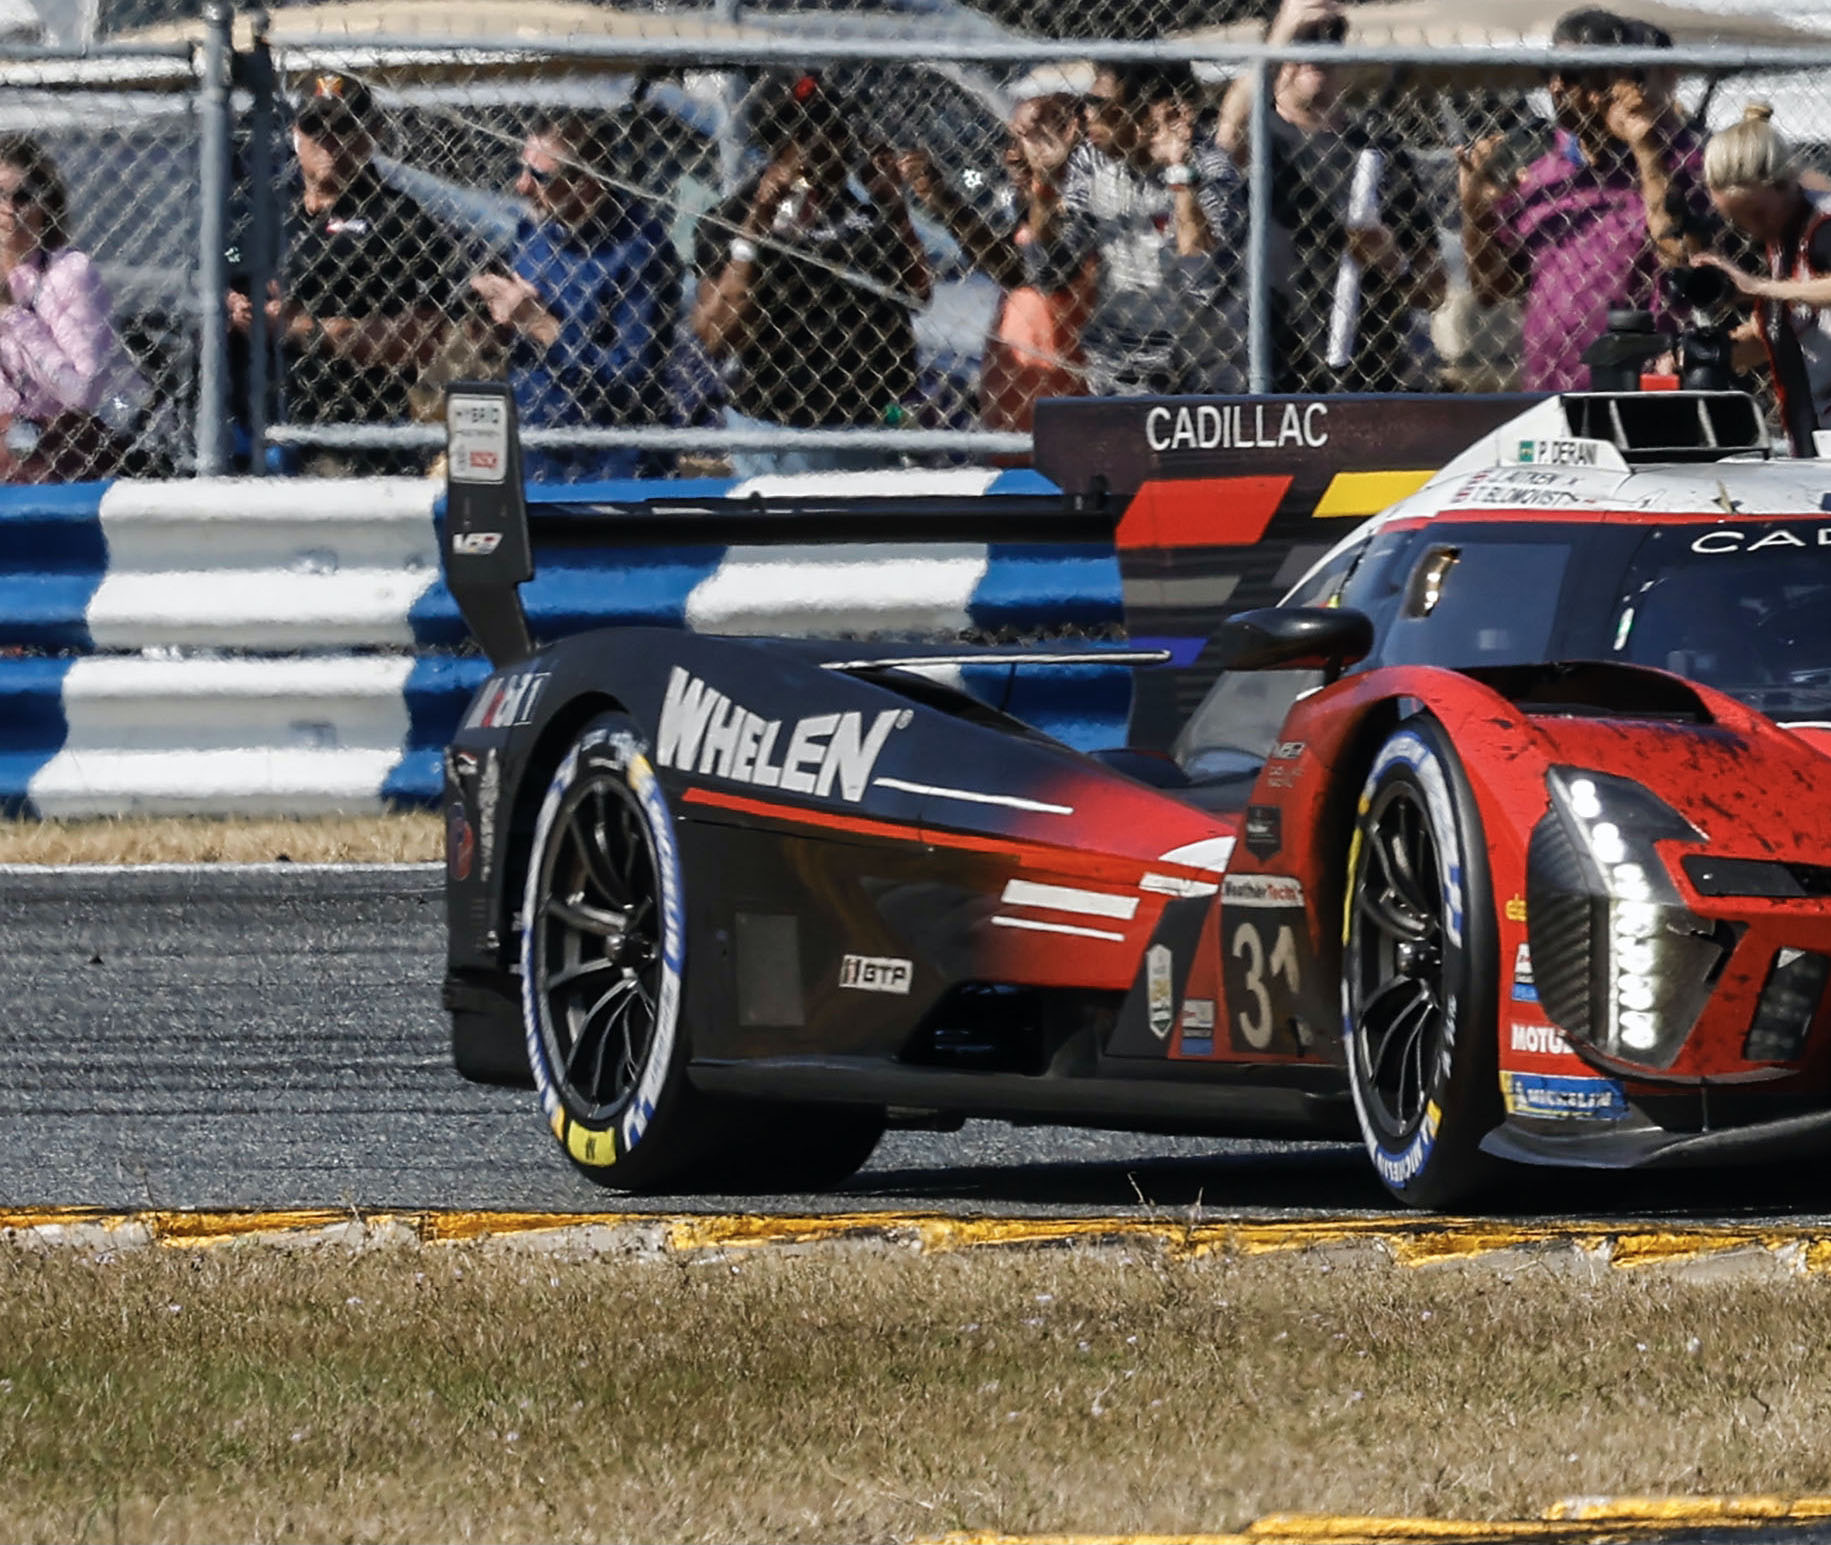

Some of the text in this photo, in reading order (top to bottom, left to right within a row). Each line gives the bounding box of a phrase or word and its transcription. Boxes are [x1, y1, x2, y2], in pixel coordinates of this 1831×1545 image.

[1146, 402, 1328, 451] CADILLAC
[656, 665, 902, 803] WHELEN
[1233, 922, 1300, 1049] 31
